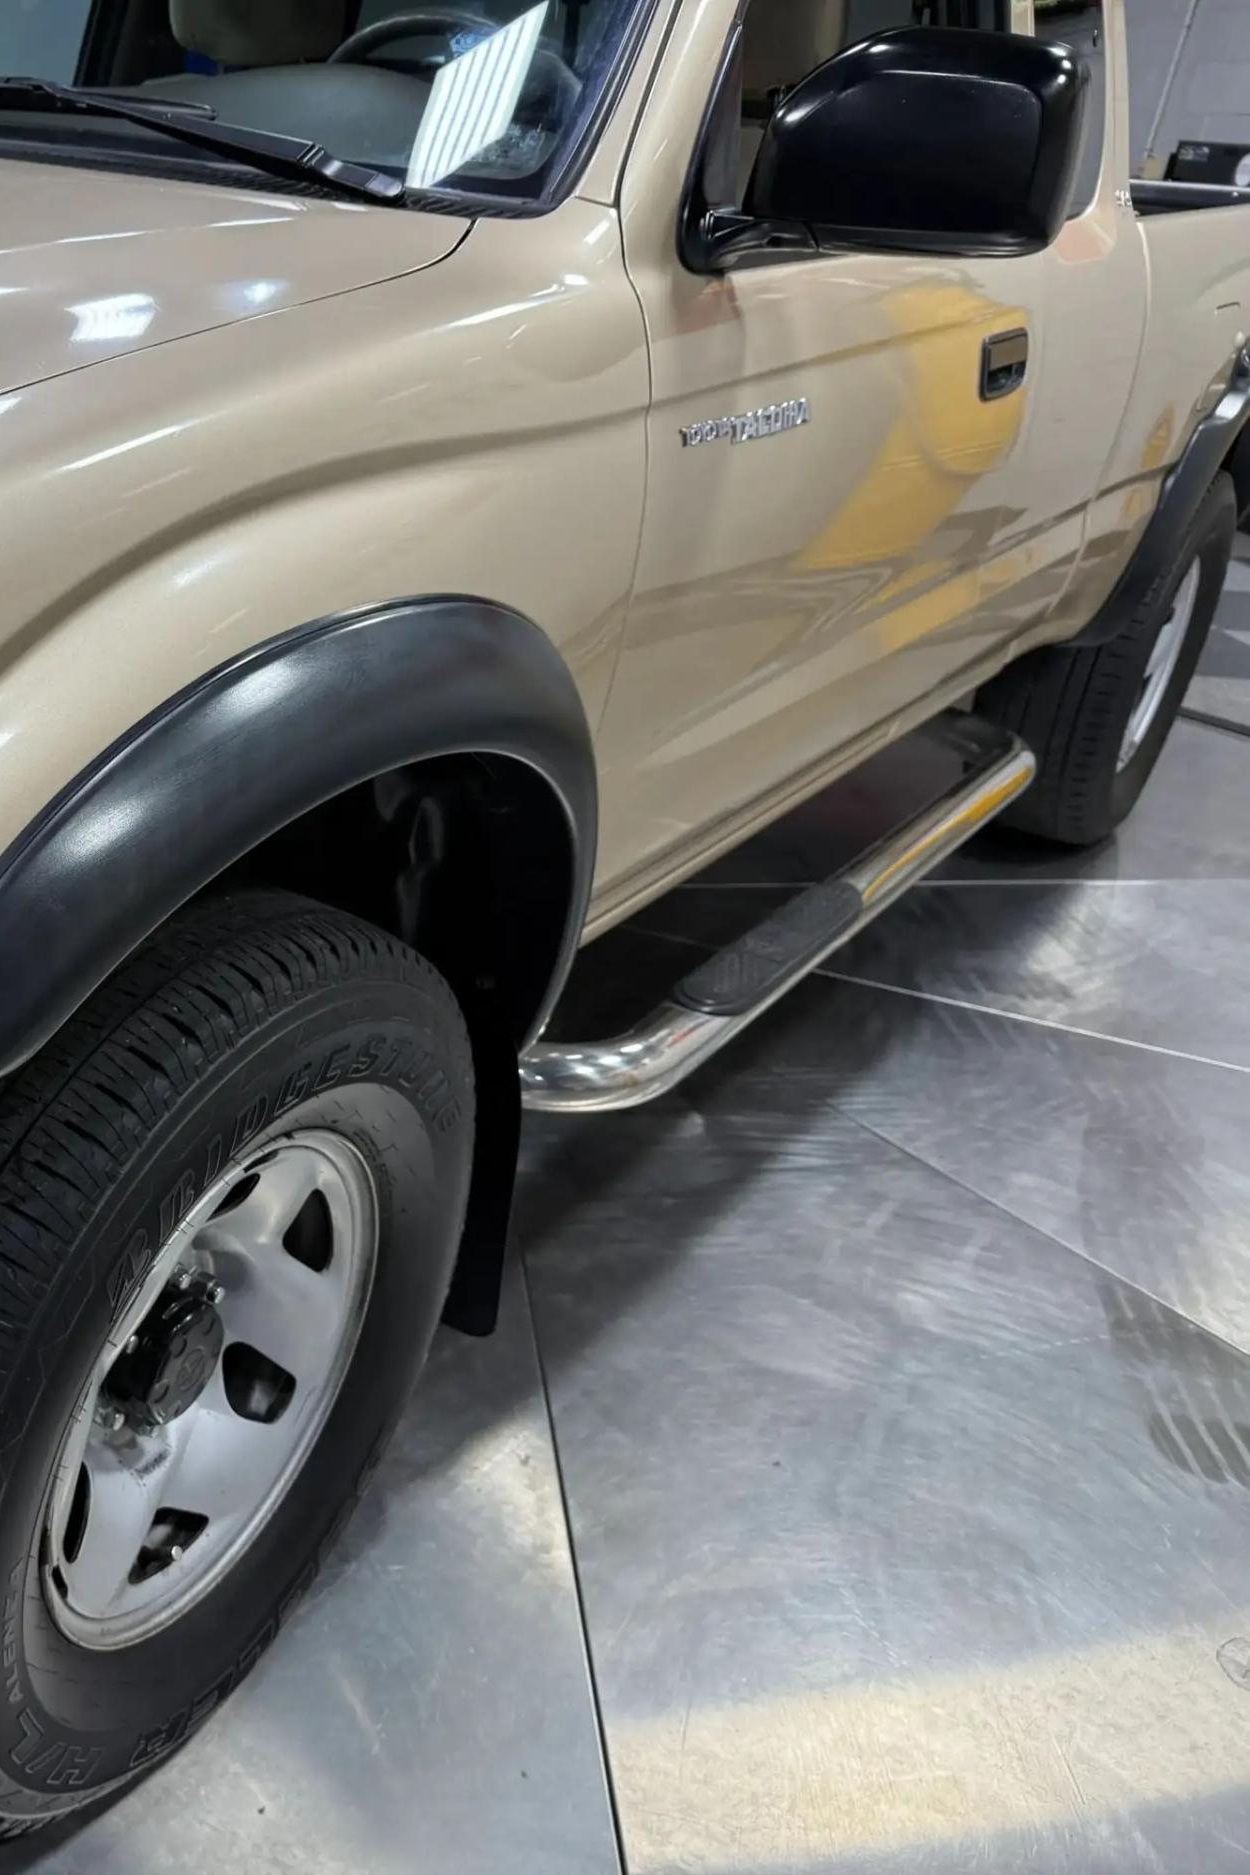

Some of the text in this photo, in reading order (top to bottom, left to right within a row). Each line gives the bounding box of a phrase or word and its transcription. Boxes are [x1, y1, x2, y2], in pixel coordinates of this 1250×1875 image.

[731, 397, 811, 445] TACOMA
[2, 1557, 26, 1704] ALENZA
[8, 1709, 104, 1785] H/L
